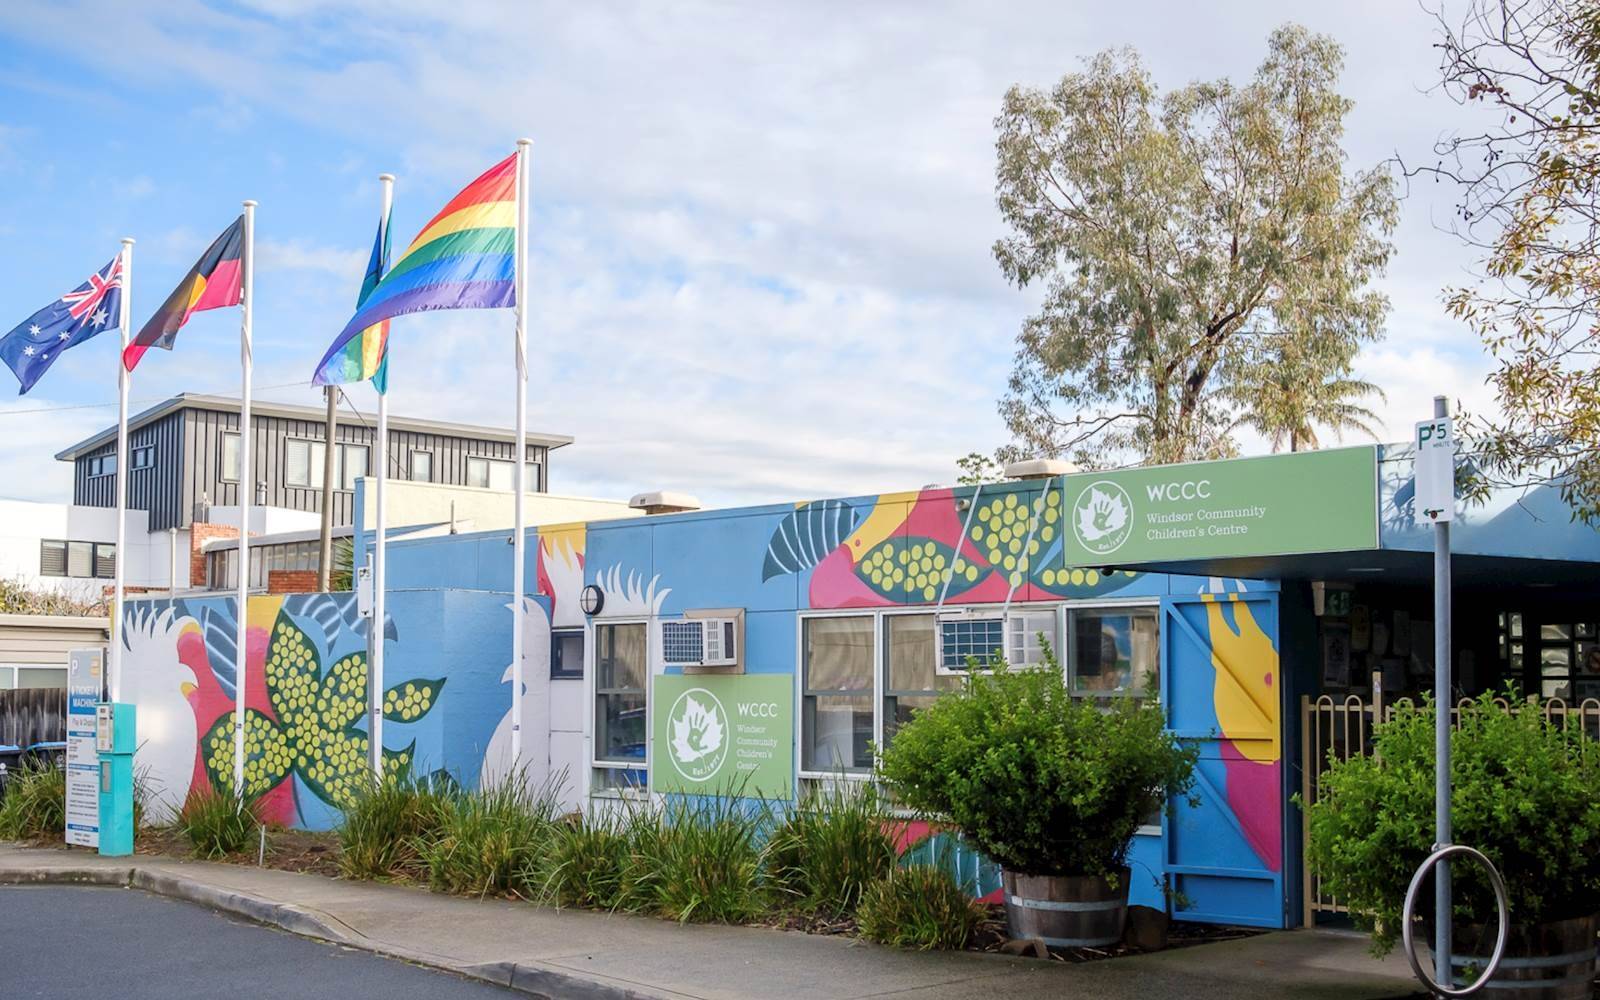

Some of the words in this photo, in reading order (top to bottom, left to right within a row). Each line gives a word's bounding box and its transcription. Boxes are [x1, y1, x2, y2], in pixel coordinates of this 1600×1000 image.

[1146, 480, 1211, 503] WCCC
[1146, 510, 1194, 525] Windsor
[1196, 504, 1267, 522] Community
[1146, 525, 1206, 541] Children's
[1207, 524, 1248, 536] Centre
[71, 659, 78, 675] P
[74, 685, 95, 696] TICKET
[737, 702, 778, 718] WCCC
[736, 724, 766, 733] Windsor
[736, 736, 778, 749] Community
[736, 749, 773, 759] Children's
